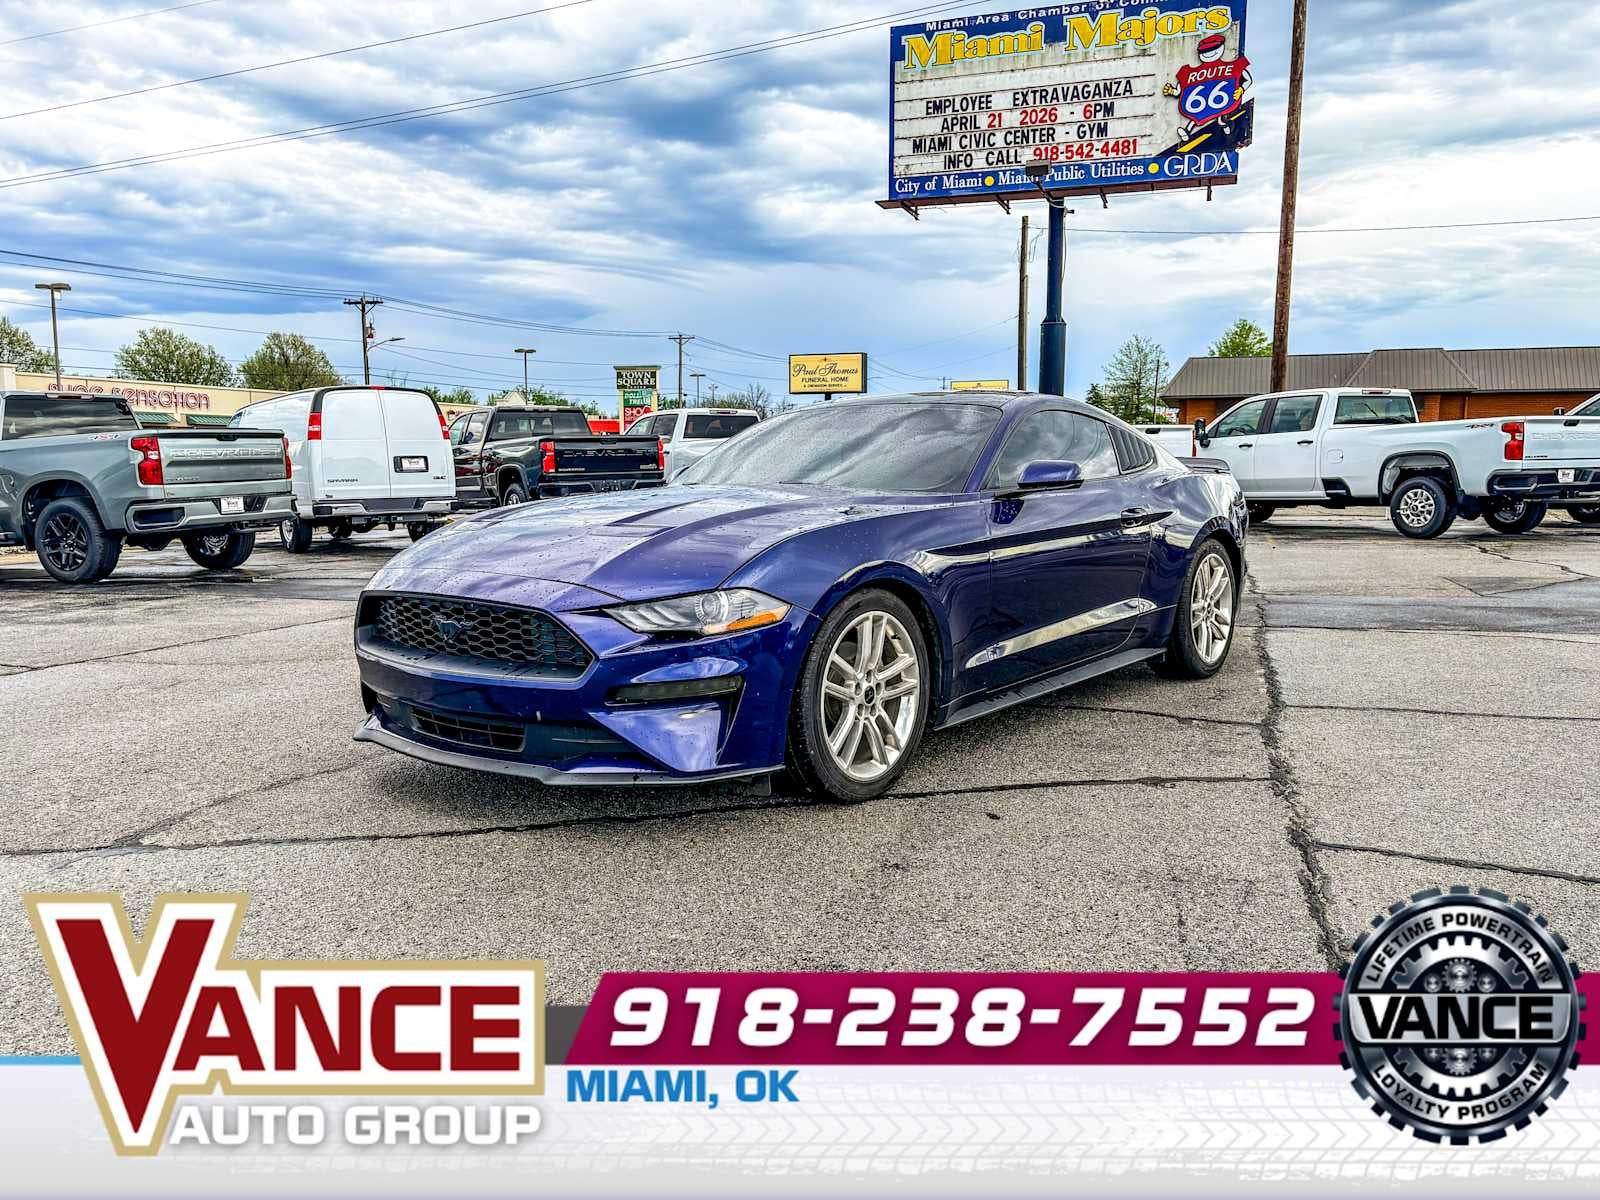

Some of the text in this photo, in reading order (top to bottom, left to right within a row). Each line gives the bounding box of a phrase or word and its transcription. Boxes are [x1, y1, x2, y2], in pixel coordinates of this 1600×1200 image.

[926, 17, 970, 31] Miami
[976, 13, 1010, 25] Area
[1017, 4, 1087, 20] Chamber
[903, 7, 1231, 70] Miami Majors
[1187, 65, 1234, 84] ROUTE
[926, 79, 1133, 115] EMPLOYEE EXTRAVAGANZA
[1184, 81, 1230, 114] 66
[941, 115, 981, 133] APRIL
[987, 112, 1002, 129] 21
[1019, 107, 1058, 126] 2026
[1083, 101, 1114, 120] 6PM
[912, 135, 951, 154] MIAMI
[959, 133, 996, 149] CIVIC
[1004, 127, 1056, 146] CENTER
[1077, 122, 1108, 140] GYM
[944, 138, 1137, 169] INFO CALL 918-542-4481
[895, 177, 919, 195] City
[925, 177, 937, 191] of
[942, 175, 982, 190] Miami
[1091, 161, 1144, 179] Utilities
[1164, 151, 1232, 177] GRDA
[617, 378, 656, 386] SQUARE
[622, 371, 651, 379] TOWN
[793, 362, 858, 377] Paul Thomas
